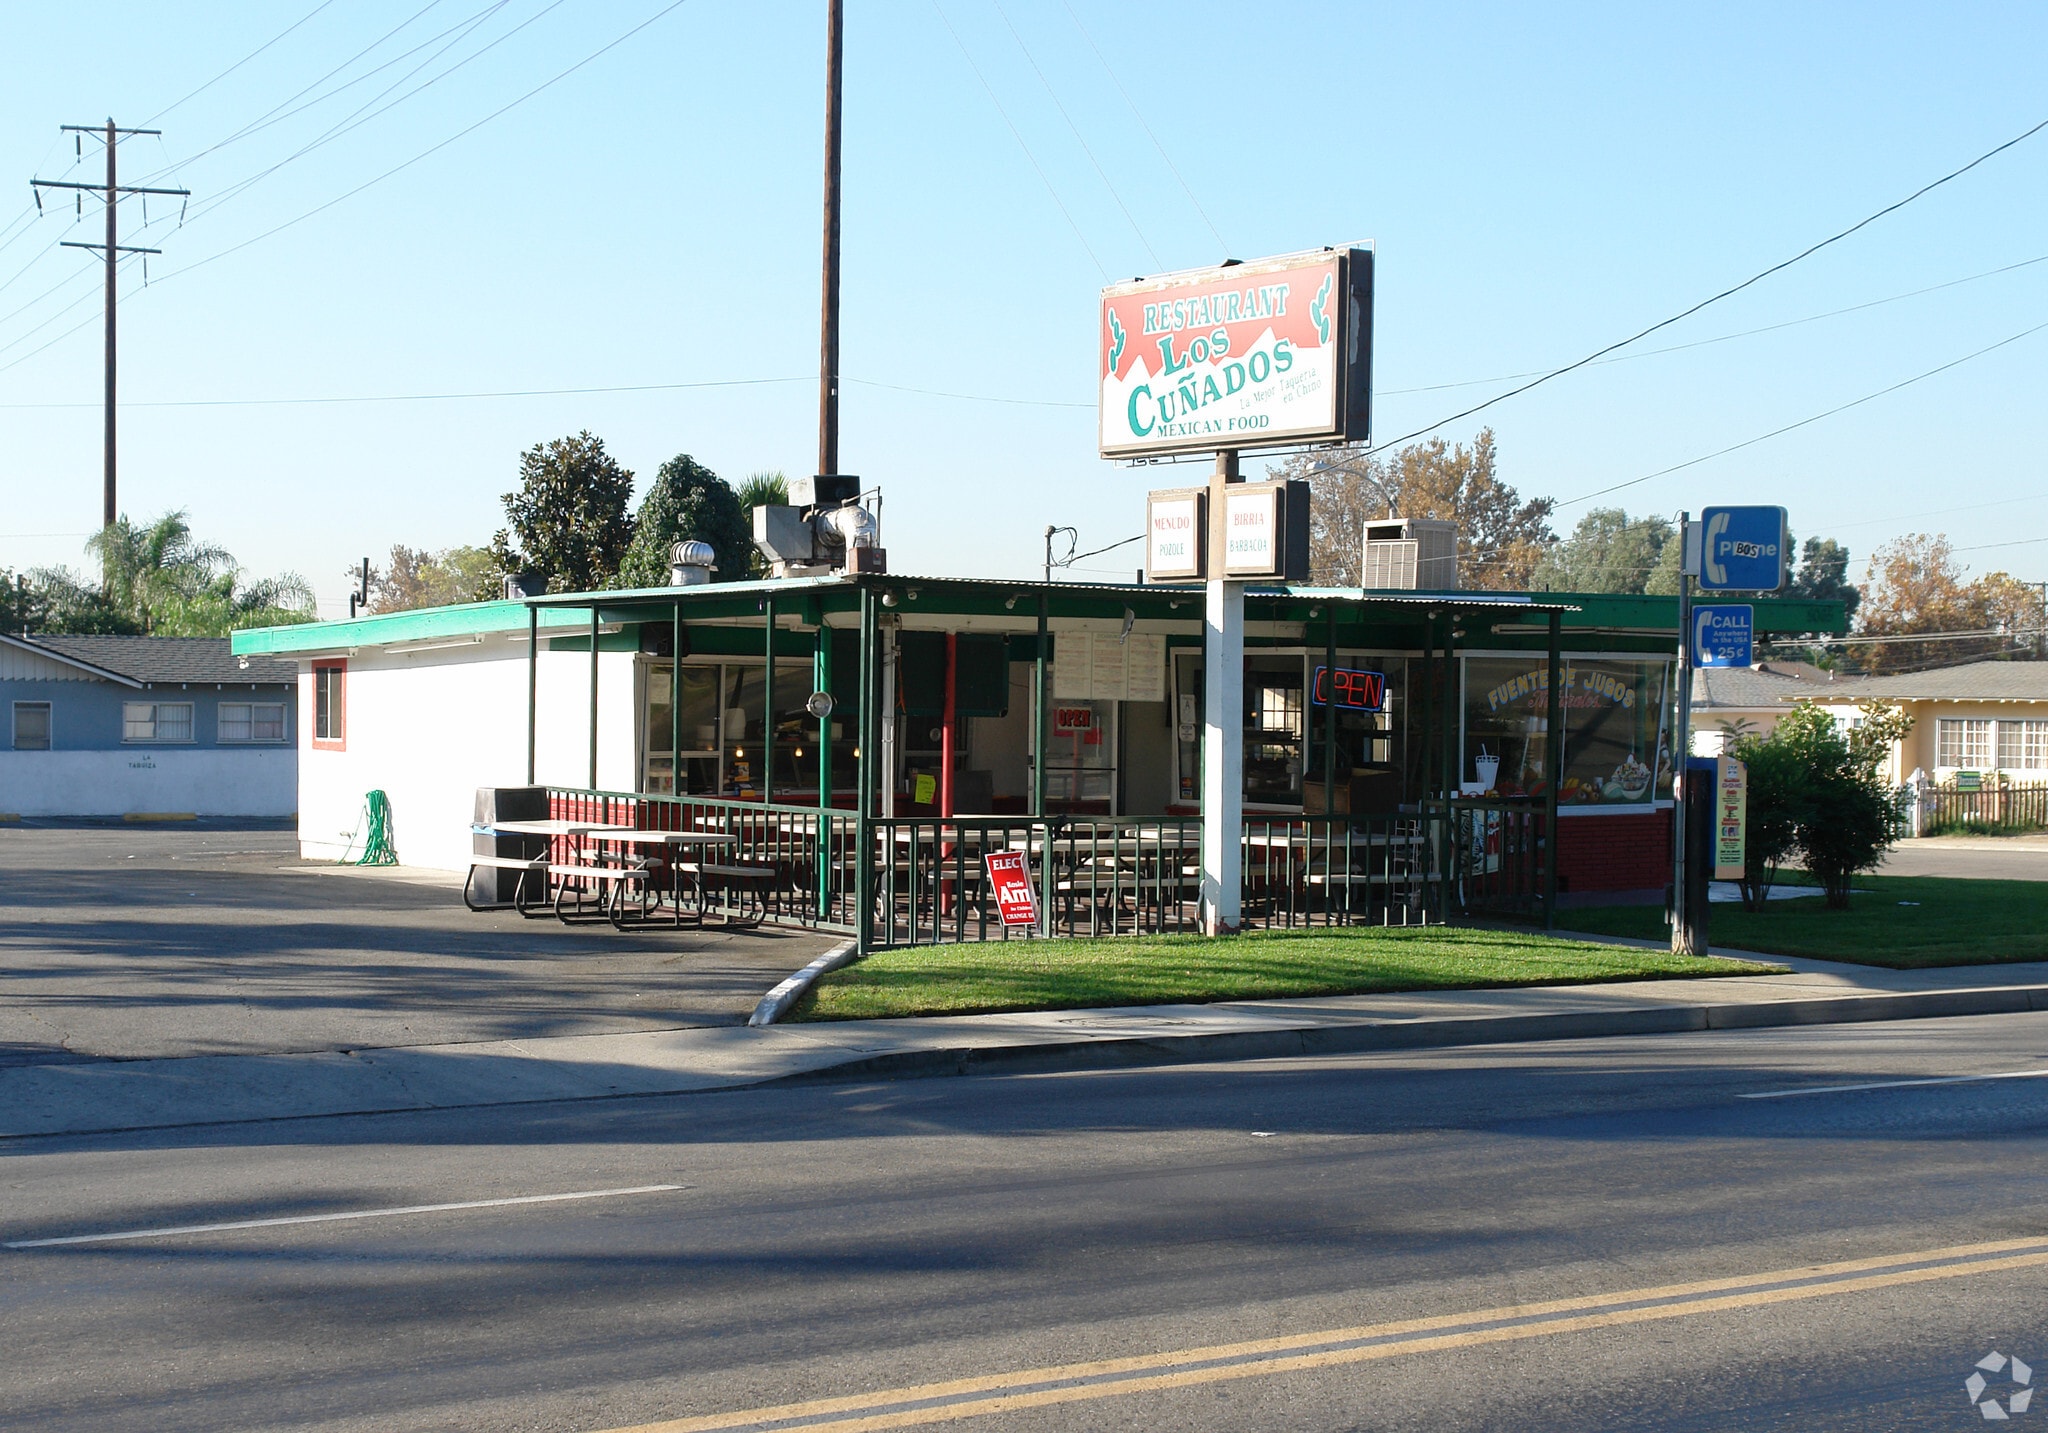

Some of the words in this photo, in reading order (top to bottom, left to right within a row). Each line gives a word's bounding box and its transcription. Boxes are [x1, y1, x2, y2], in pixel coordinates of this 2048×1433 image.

[1144, 286, 1288, 333] RESTAURANT
[1157, 419, 1222, 438] MEXICAN
[1228, 415, 1269, 430] FOOD
[1154, 516, 1190, 530] MENUDO
[1234, 513, 1264, 526] BIRRIA
[1159, 543, 1184, 556] POZOLE
[1230, 539, 1267, 552] BARBACOA
[1712, 615, 1749, 628] CALL
[1488, 668, 1548, 712] FUENTE
[1583, 671, 1636, 709] JUGOS
[1058, 708, 1091, 727] OPEN
